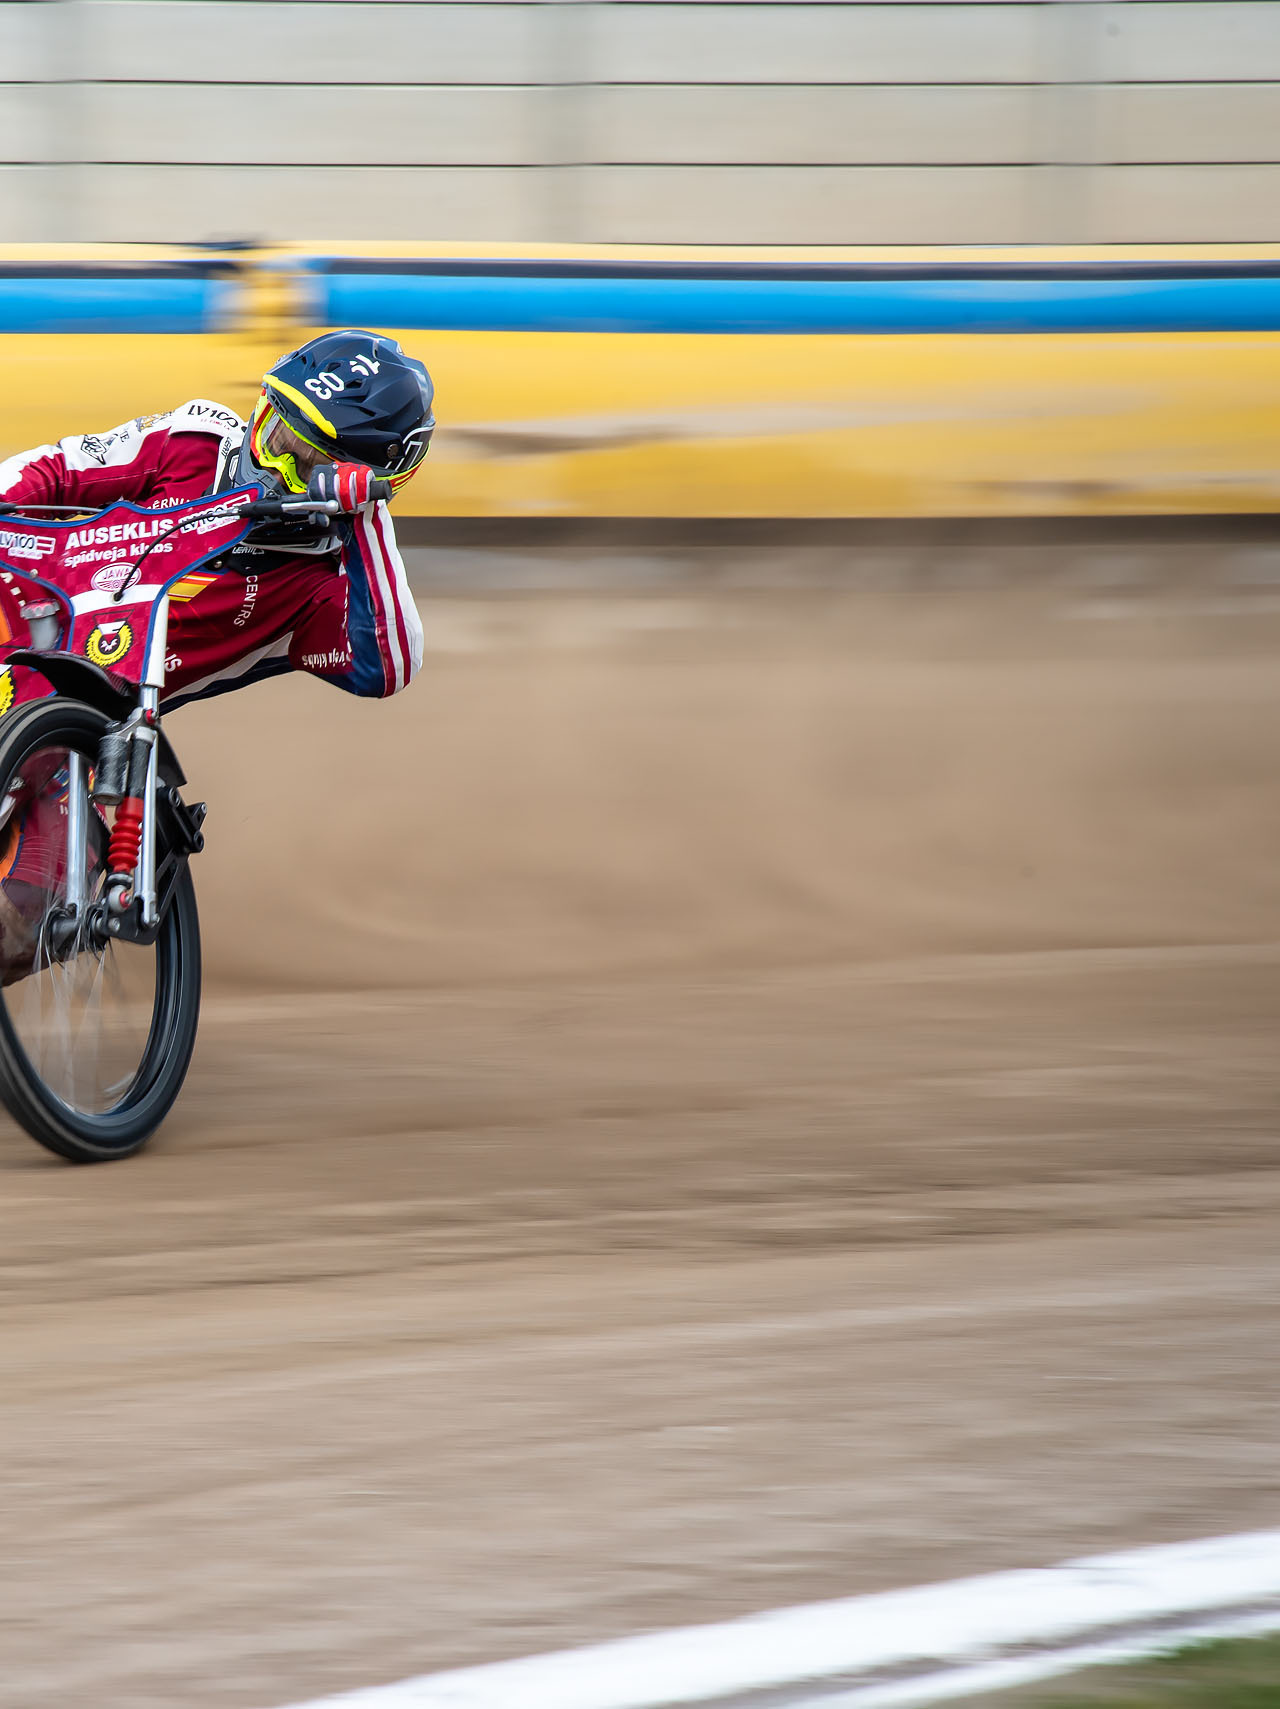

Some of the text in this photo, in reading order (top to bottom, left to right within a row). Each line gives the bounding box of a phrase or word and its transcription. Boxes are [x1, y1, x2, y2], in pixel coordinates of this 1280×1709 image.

[305, 372, 345, 400] 03
[64, 519, 174, 551] AUSEKLIS
[130, 542, 173, 557] klbs
[103, 567, 130, 579] JAWA
[234, 575, 258, 627] CENTRS
